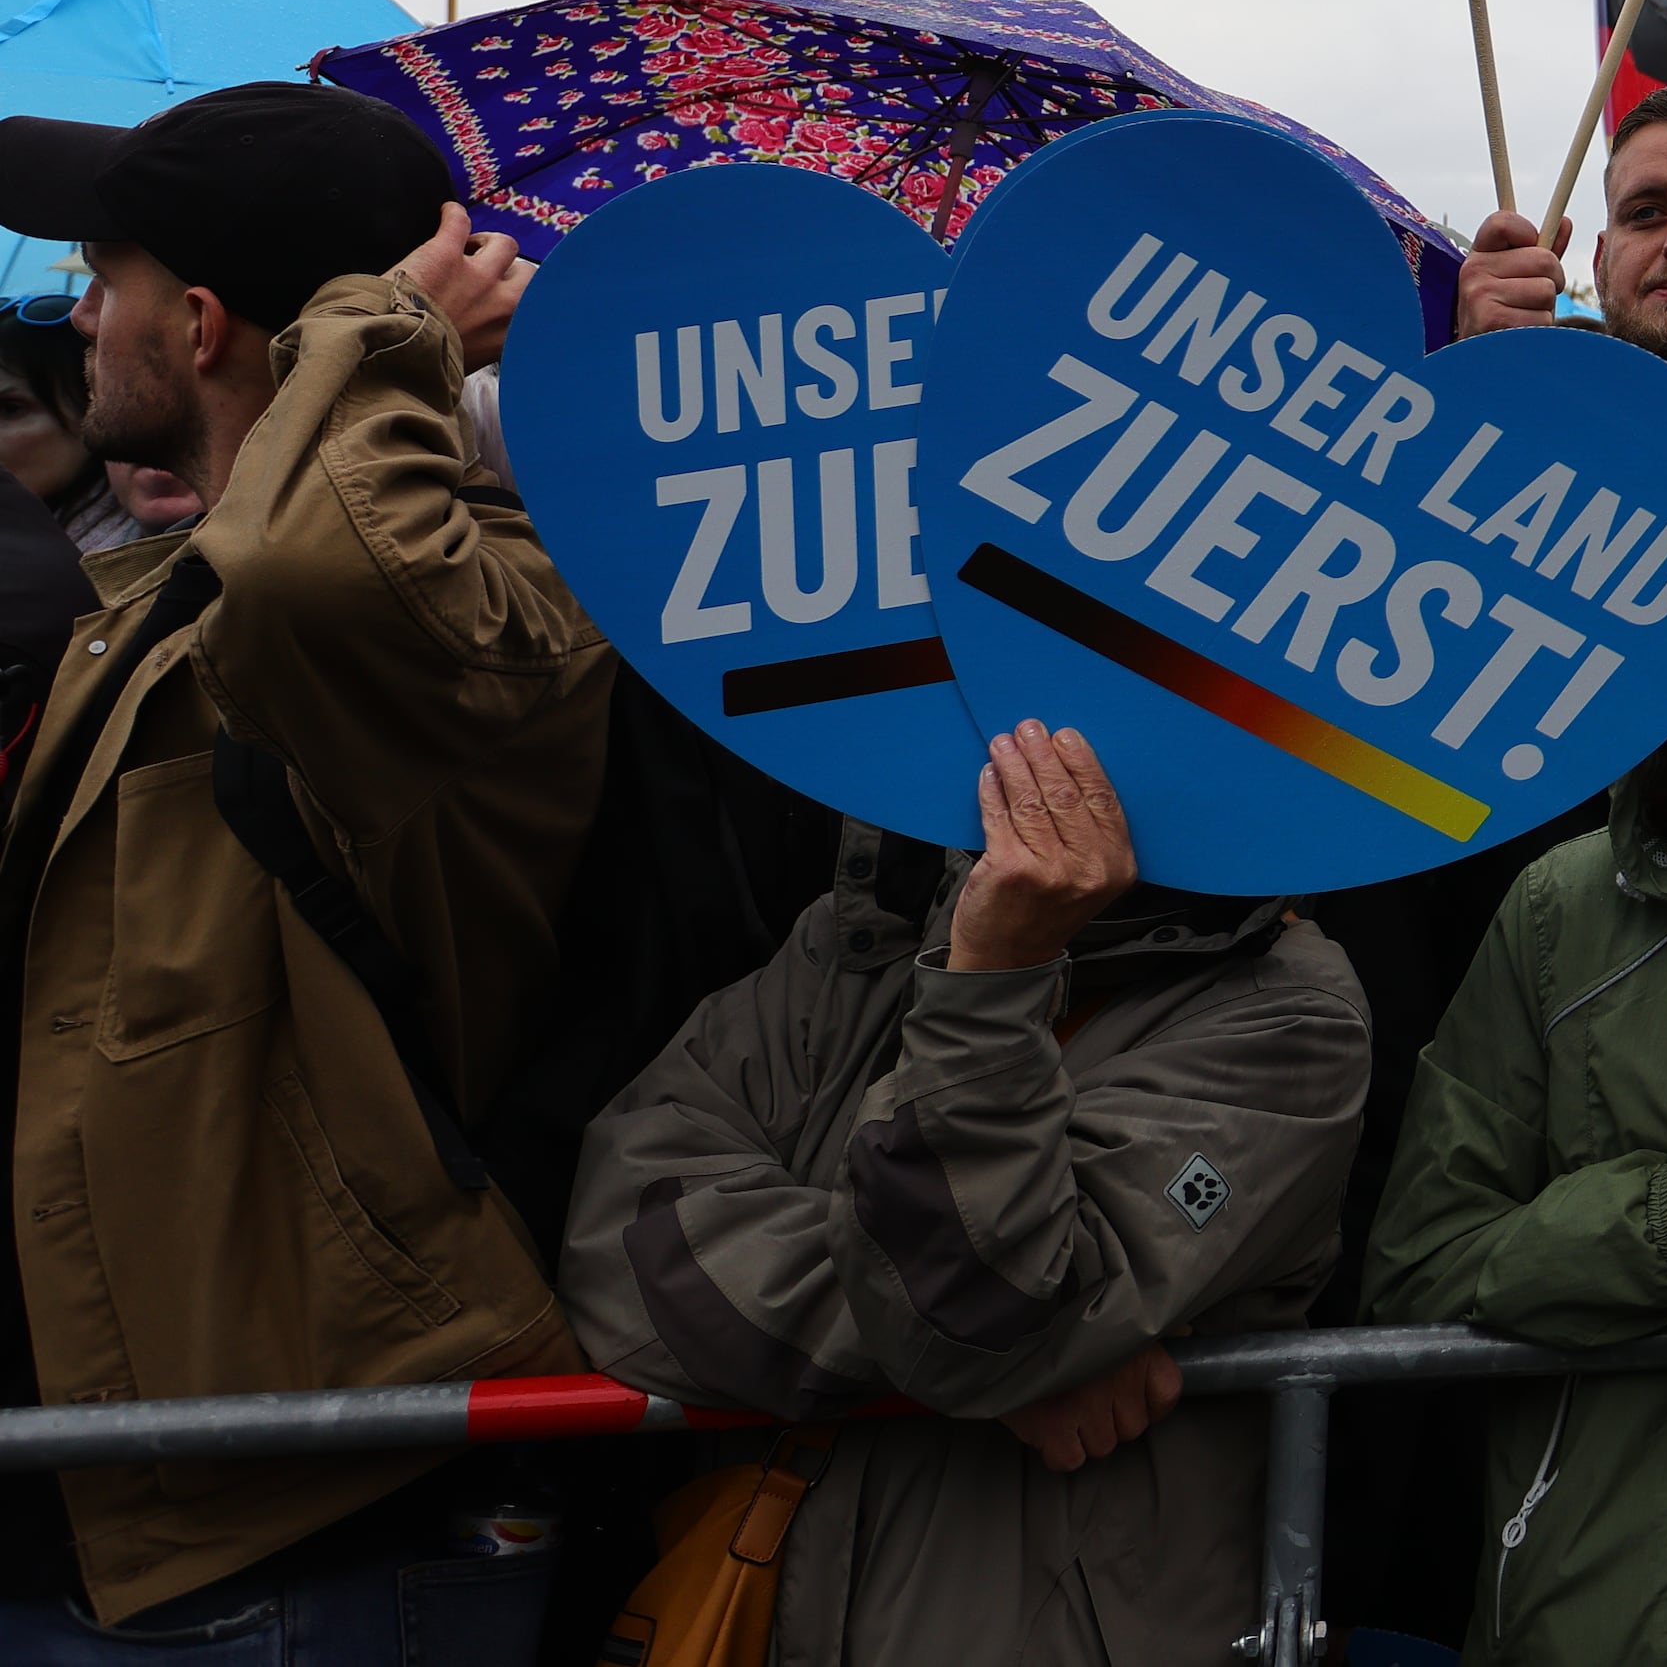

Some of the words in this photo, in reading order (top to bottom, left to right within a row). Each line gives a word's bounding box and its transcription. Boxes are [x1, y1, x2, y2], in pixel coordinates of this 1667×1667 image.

[635, 289, 948, 443] UNSE
[1087, 232, 1435, 485] UNSER
[959, 354, 1625, 780] ZUERST!
